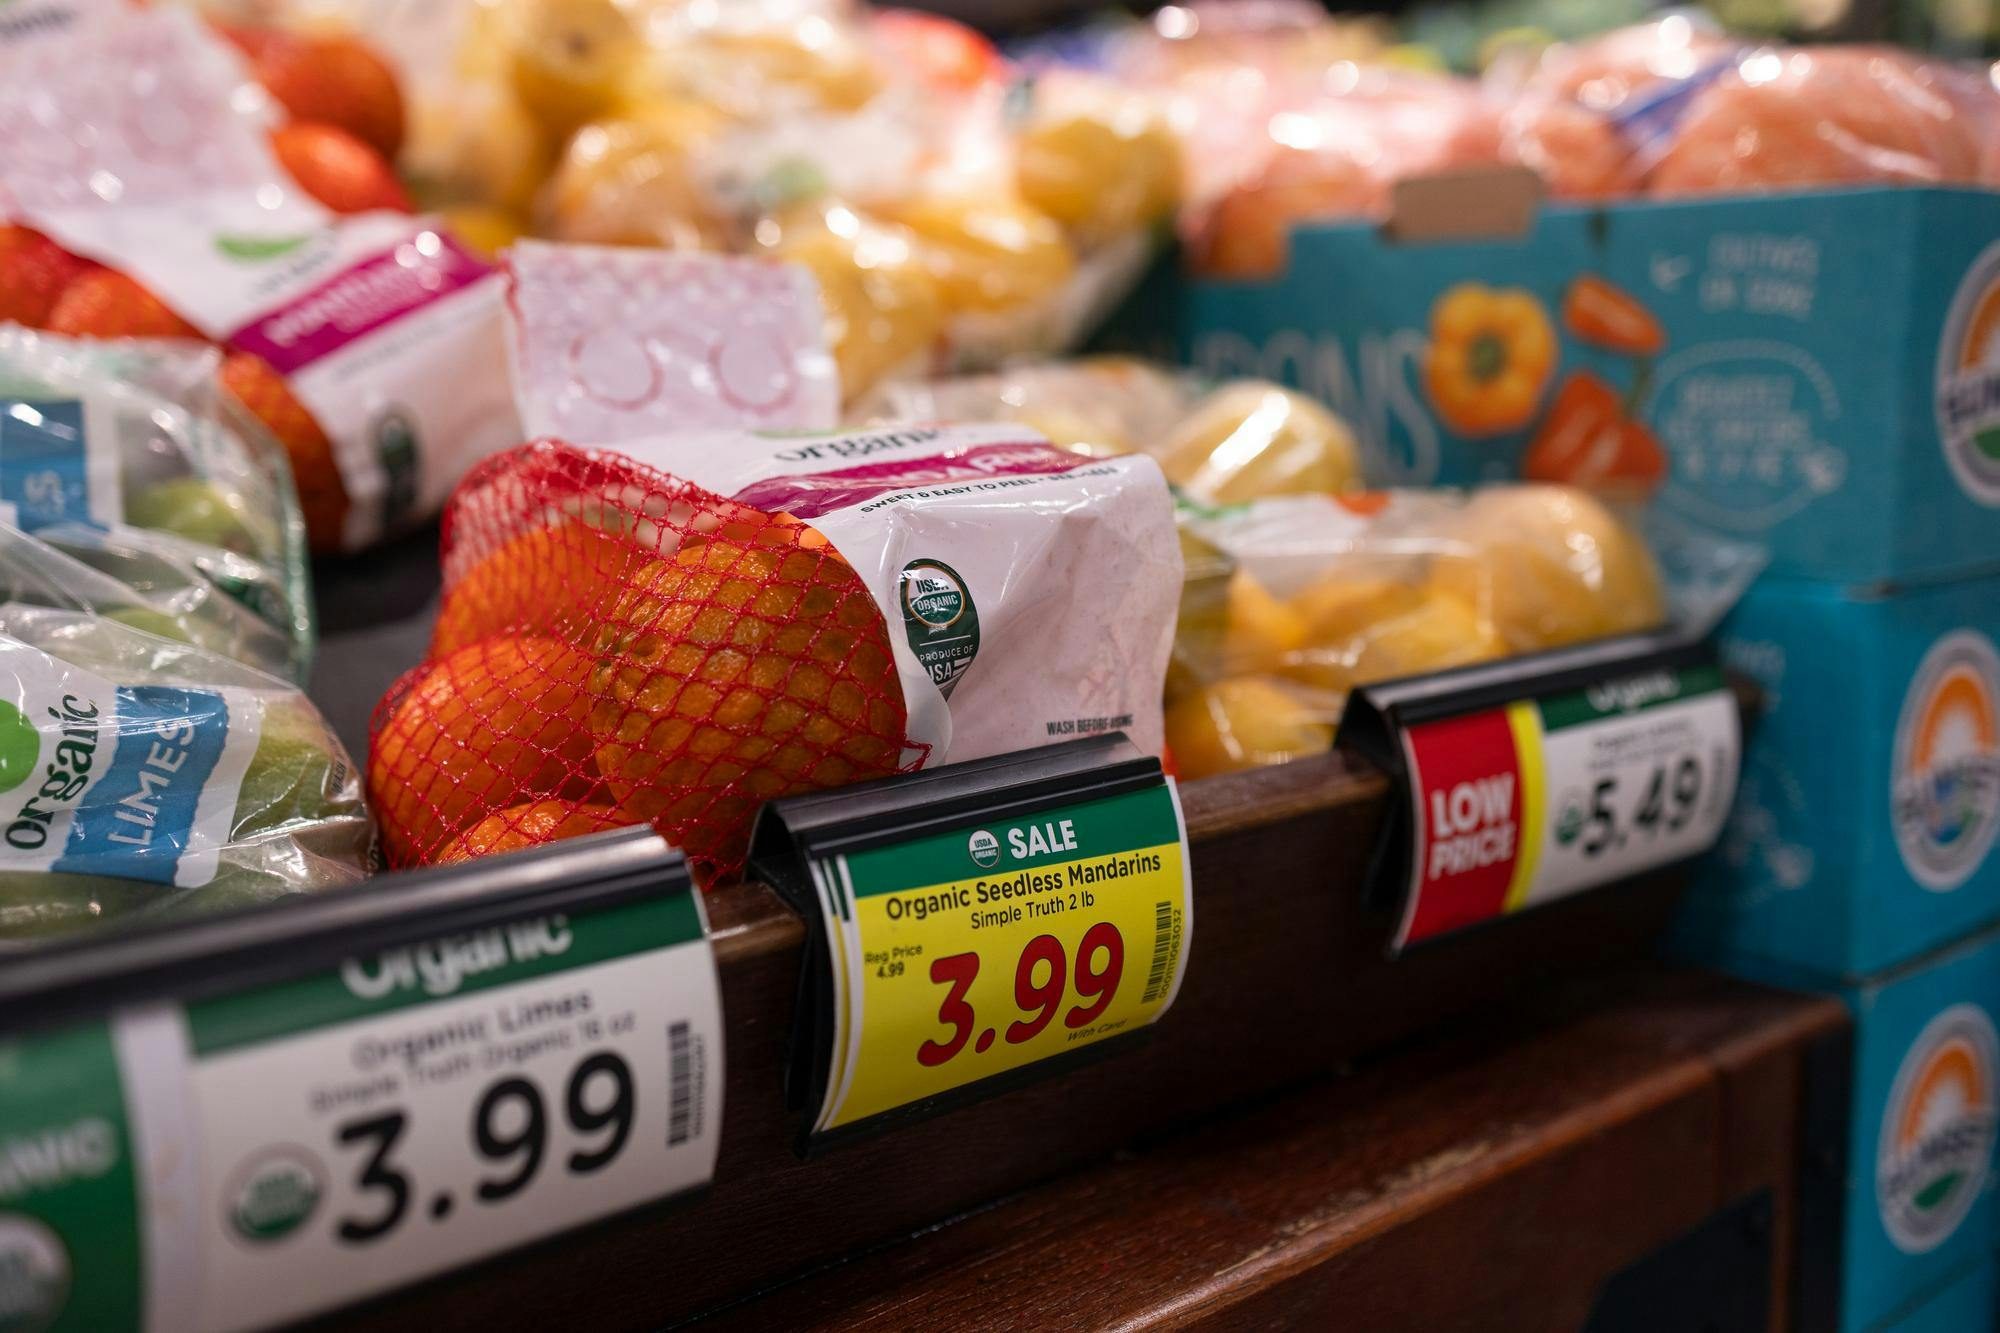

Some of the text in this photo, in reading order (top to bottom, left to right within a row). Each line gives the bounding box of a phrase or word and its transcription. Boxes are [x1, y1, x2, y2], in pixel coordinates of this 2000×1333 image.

[860, 491, 915, 513] SWEET
[931, 486, 973, 497] EASY
[974, 482, 997, 491] TO
[1000, 476, 1034, 488] PEEL
[917, 595, 958, 611] ORGANIC
[920, 644, 974, 663] PRODUCE OF
[1046, 720, 1075, 736] WASH
[4, 694, 99, 850] organic
[106, 720, 195, 847] LIMES
[1429, 772, 1515, 839] LOW
[1583, 756, 1700, 859] 5.49
[974, 838, 993, 849] USDA
[1008, 819, 1078, 859] SALE
[1428, 821, 1516, 882] PRICE
[886, 853, 1161, 920] Organic Seedless Mandarins
[971, 890, 1095, 930] Simple Truth 2 lb
[864, 945, 923, 965] Reg Price
[876, 961, 905, 978] 4.99
[917, 922, 1125, 1068] 3.99
[353, 989, 594, 1069] Organic Limes
[336, 1048, 637, 1244] 3.99
